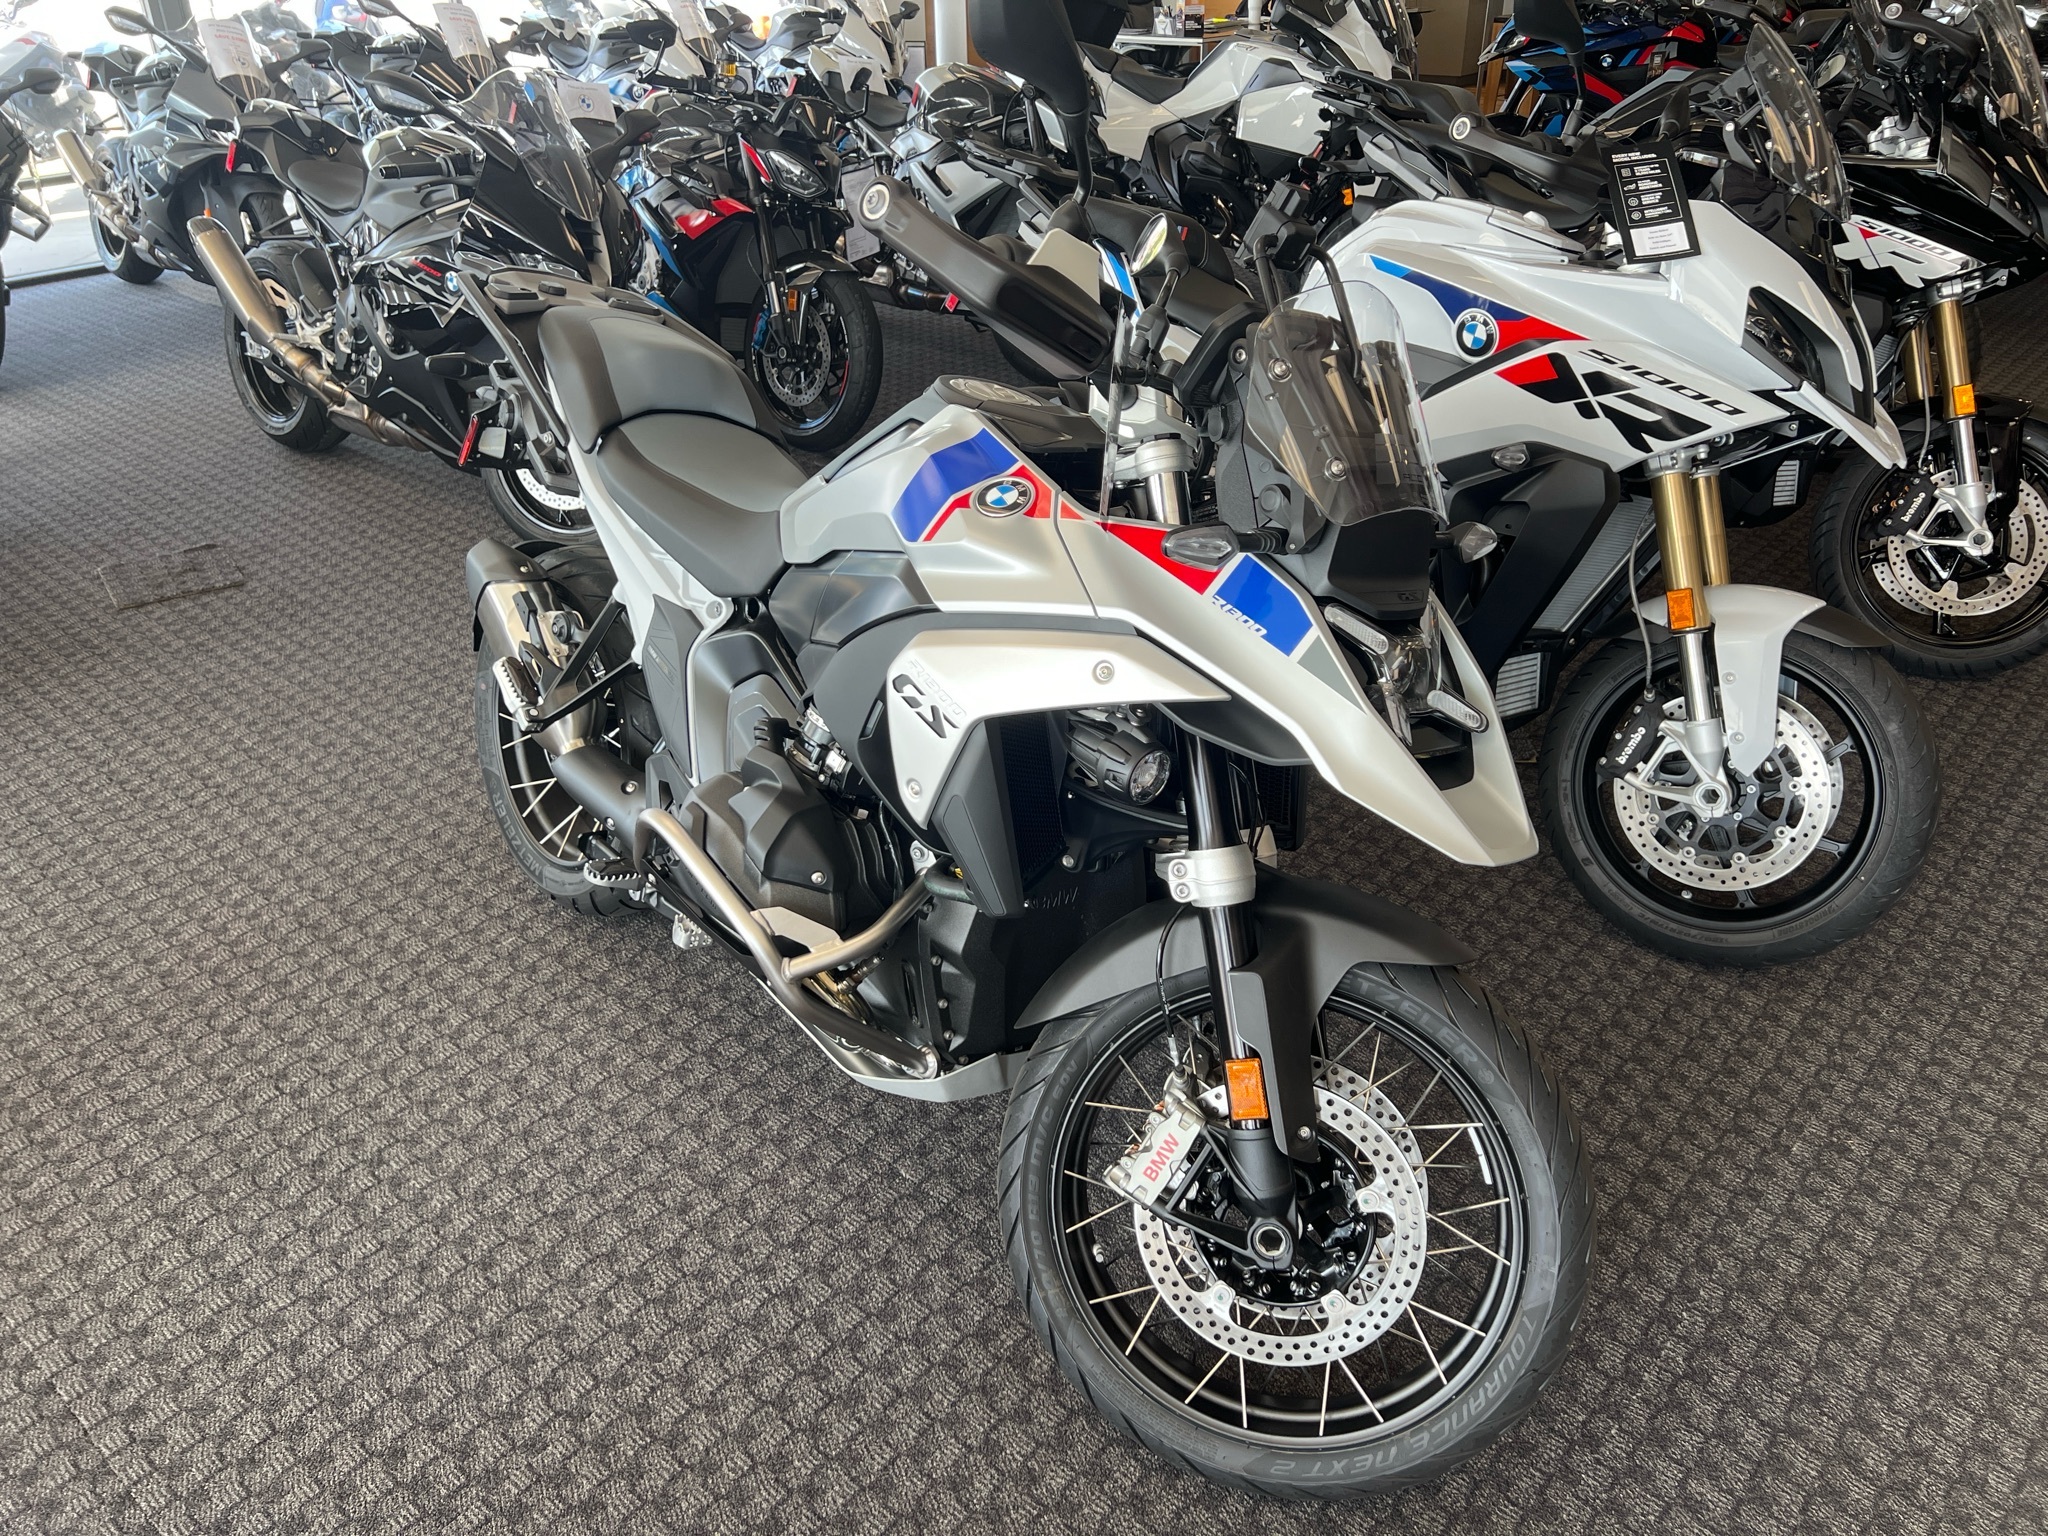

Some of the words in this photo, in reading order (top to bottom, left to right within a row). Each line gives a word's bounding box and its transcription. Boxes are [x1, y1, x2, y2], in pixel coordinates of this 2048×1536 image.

[1853, 219, 1952, 256] S1000
[1577, 348, 1748, 416] S1000
[1900, 492, 1926, 523] brembo
[1211, 594, 1268, 637] R1300
[892, 673, 960, 739] GS
[1615, 726, 1646, 765] brembo
[492, 791, 540, 877] METZELER
[1338, 973, 1478, 1066] ETZELER
[1142, 1132, 1180, 1182] BMW
[1410, 1314, 1537, 1457] TOURANCE
[1270, 1459, 1296, 1475] 2
[1302, 1445, 1398, 1478] NEXT
